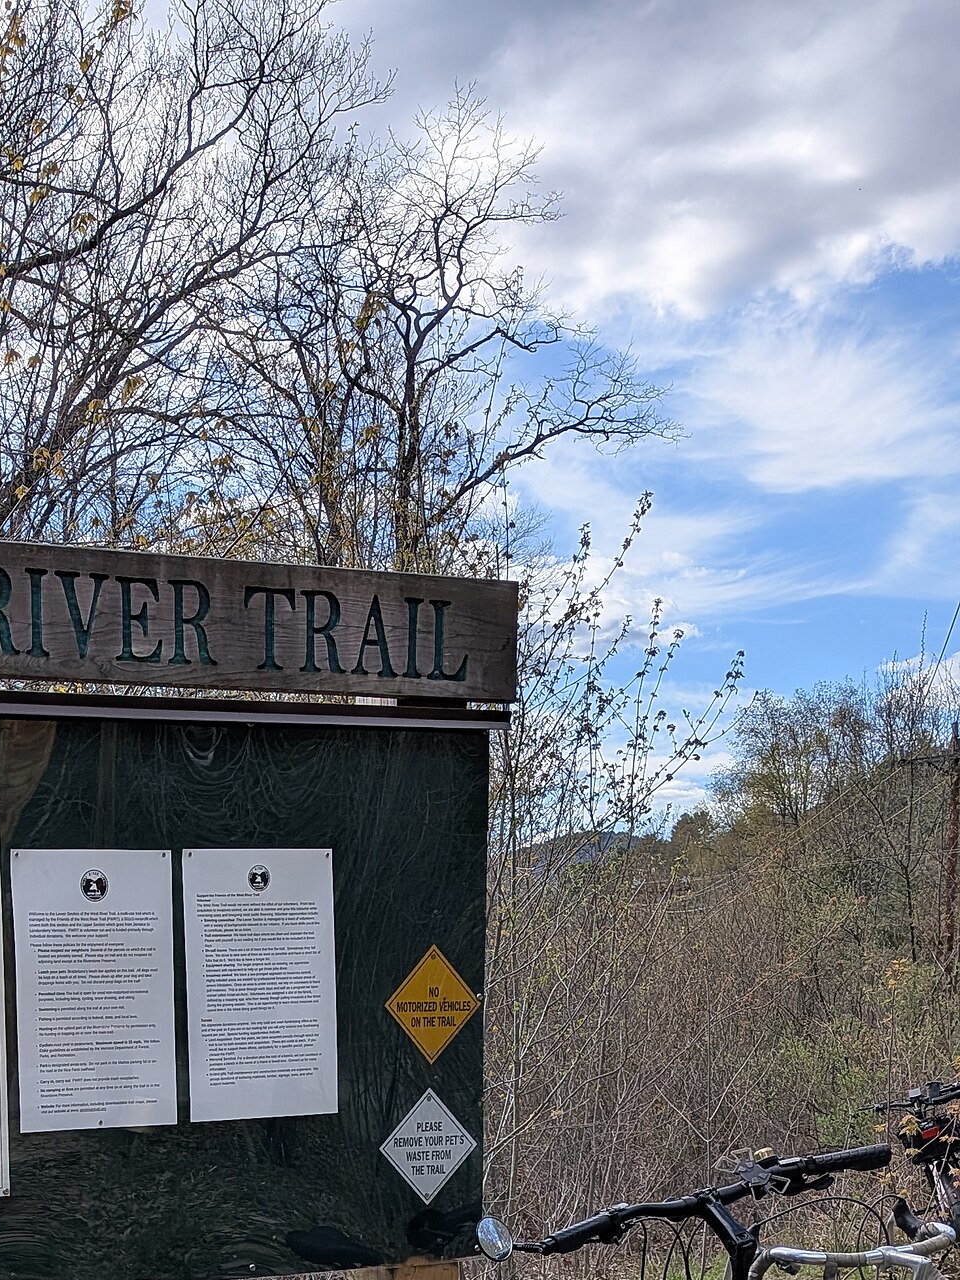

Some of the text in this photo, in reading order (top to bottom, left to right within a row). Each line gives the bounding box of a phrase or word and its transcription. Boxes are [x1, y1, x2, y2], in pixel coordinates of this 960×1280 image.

[244, 585, 468, 681] TRAIL
[428, 986, 440, 997] NO
[397, 1001, 471, 1012] MOTORIZED VEHICLES
[411, 1016, 456, 1027] ON THE TRAIL
[416, 1121, 442, 1132] PLEASE
[393, 1136, 423, 1147] REMOVE
[425, 1135, 444, 1146] YOUR
[406, 1149, 451, 1161] WASTE FROM
[411, 1164, 446, 1175] THE TRAIL
